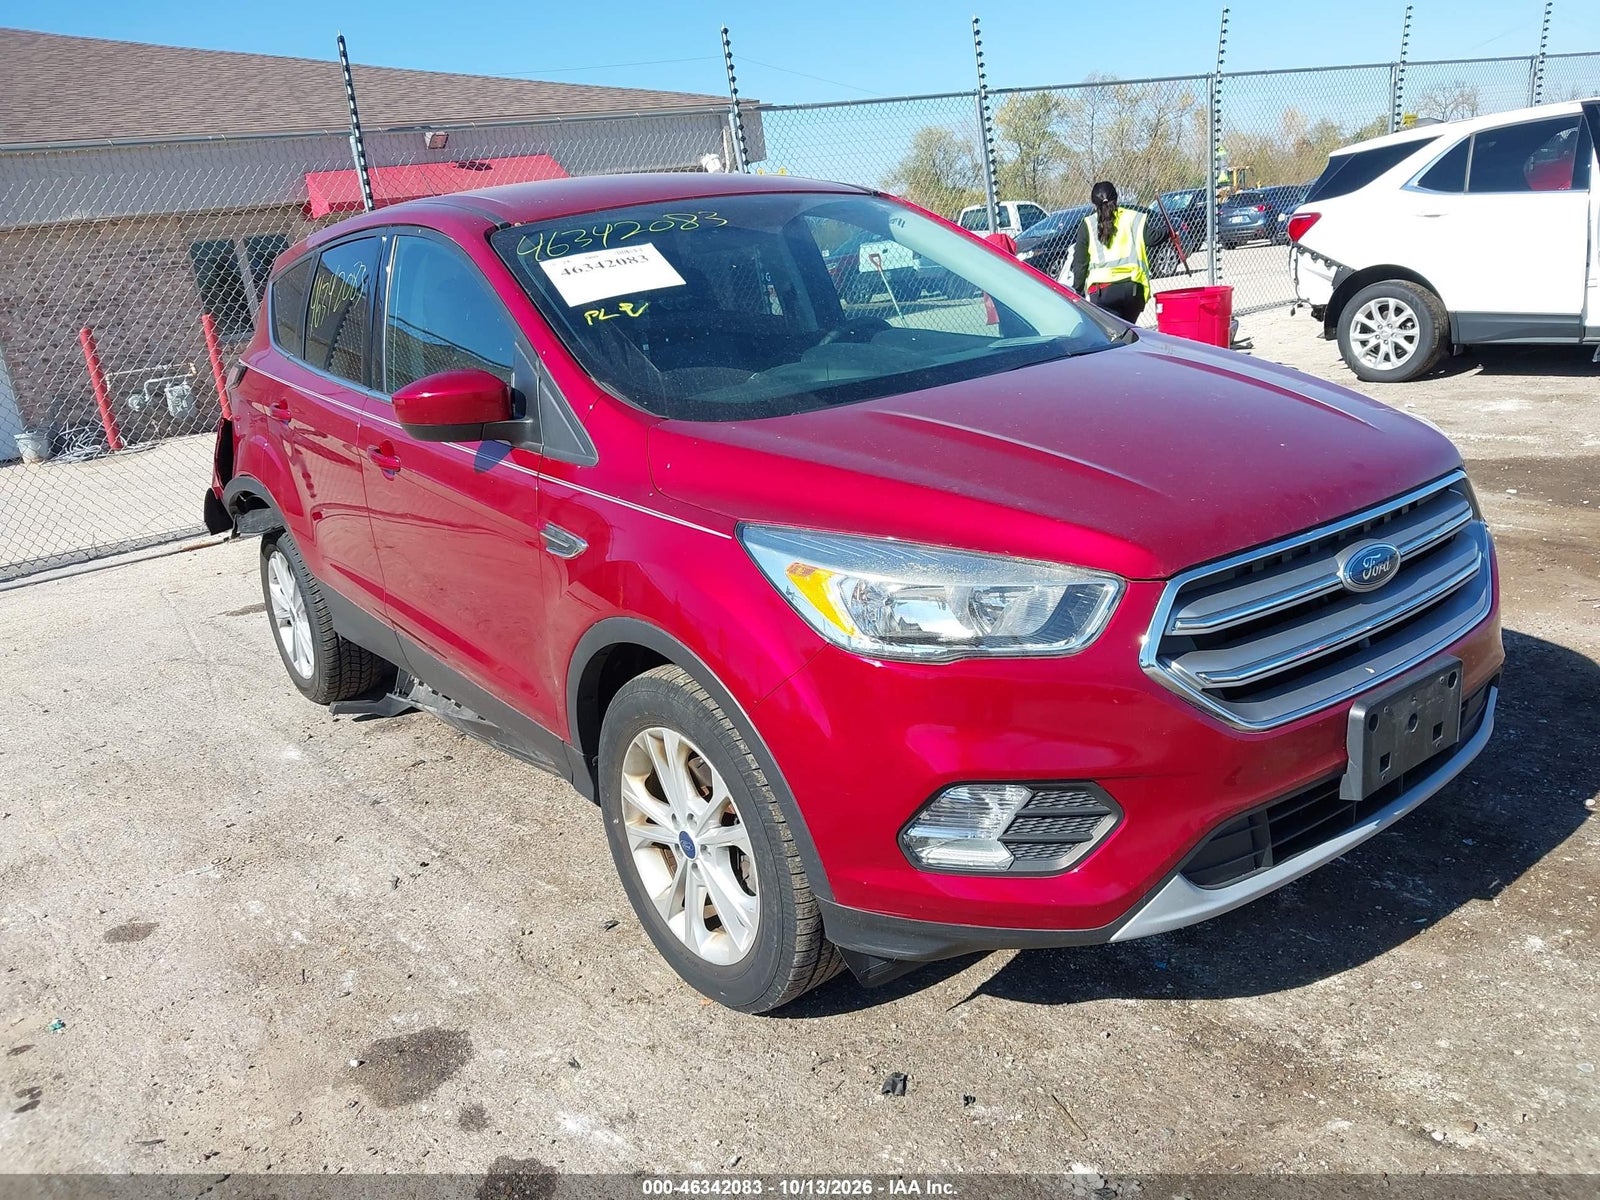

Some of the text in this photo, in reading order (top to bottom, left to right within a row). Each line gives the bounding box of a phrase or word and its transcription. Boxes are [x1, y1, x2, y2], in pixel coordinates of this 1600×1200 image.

[516, 211, 728, 262] 46342083
[561, 254, 649, 276] 46342083
[1362, 553, 1392, 580] Ford
